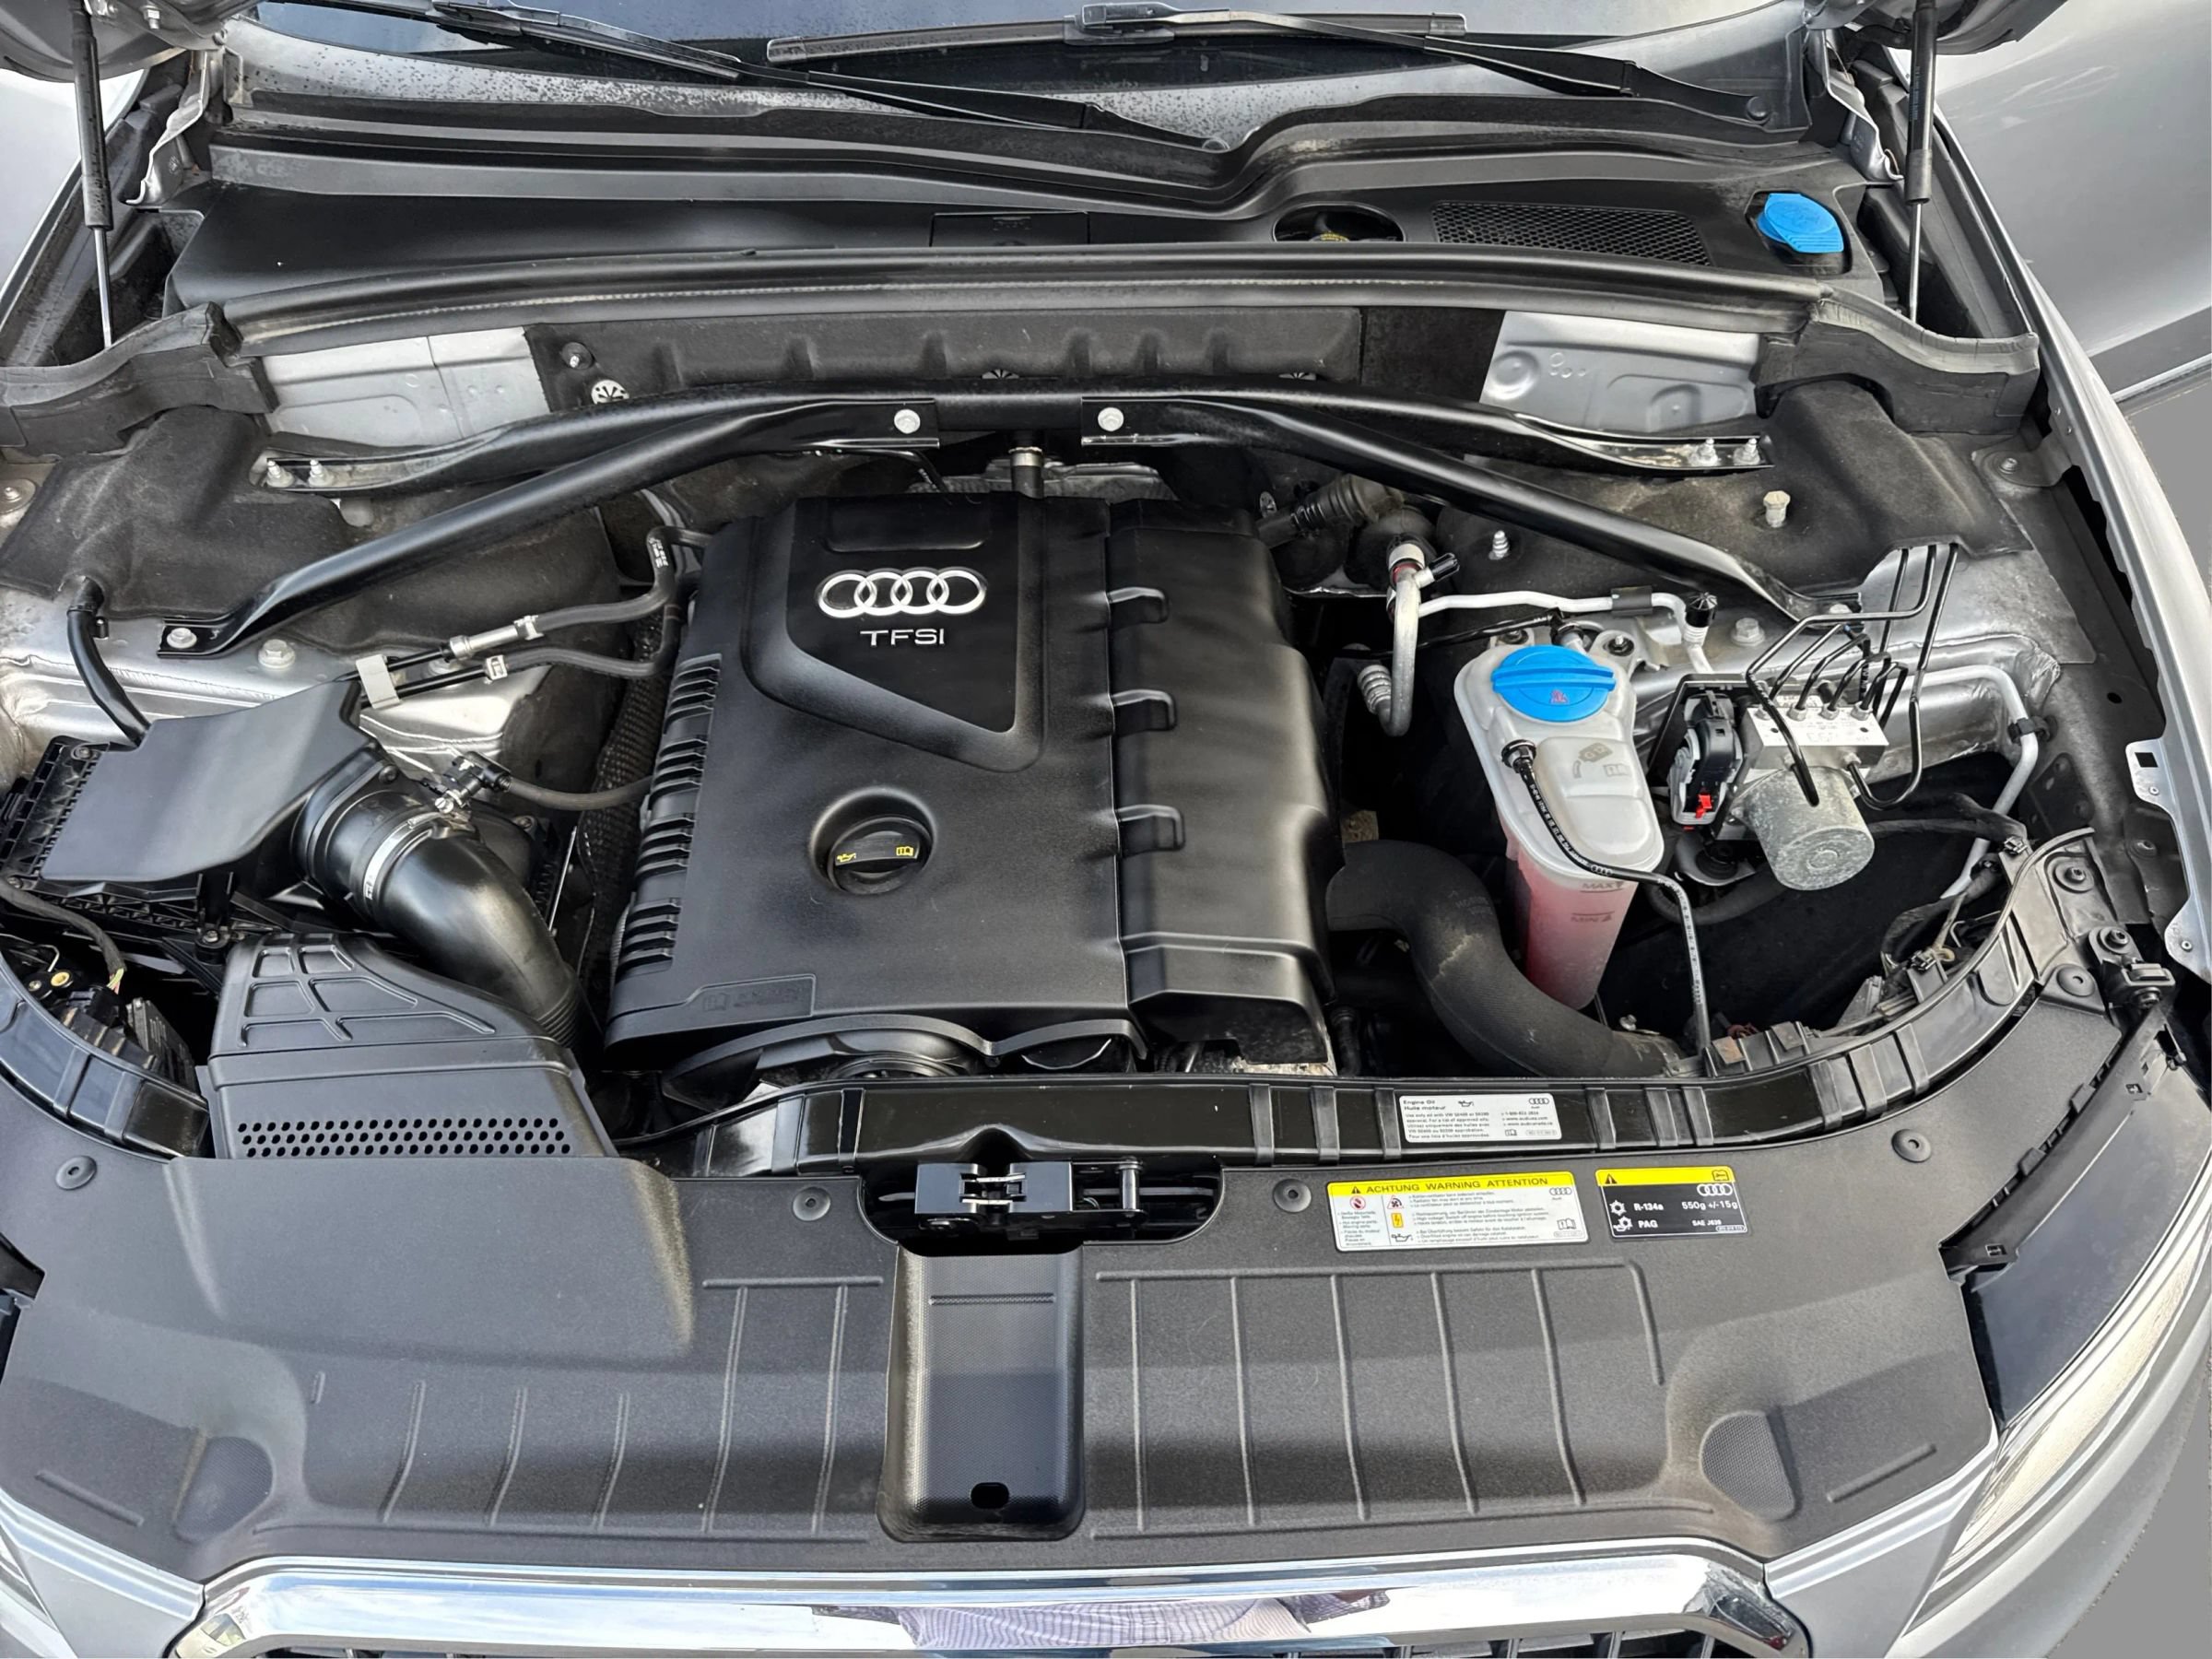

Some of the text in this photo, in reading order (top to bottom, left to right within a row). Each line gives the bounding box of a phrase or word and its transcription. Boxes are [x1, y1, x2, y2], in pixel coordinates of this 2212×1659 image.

[860, 629, 945, 645] TFSI
[1366, 1178, 1548, 1194] ACHTUNG WARNING ATTENTION
[1634, 1203, 1664, 1211] R-134a
[1682, 1201, 1706, 1211] 550g
[1638, 1220, 1658, 1229] PAG
